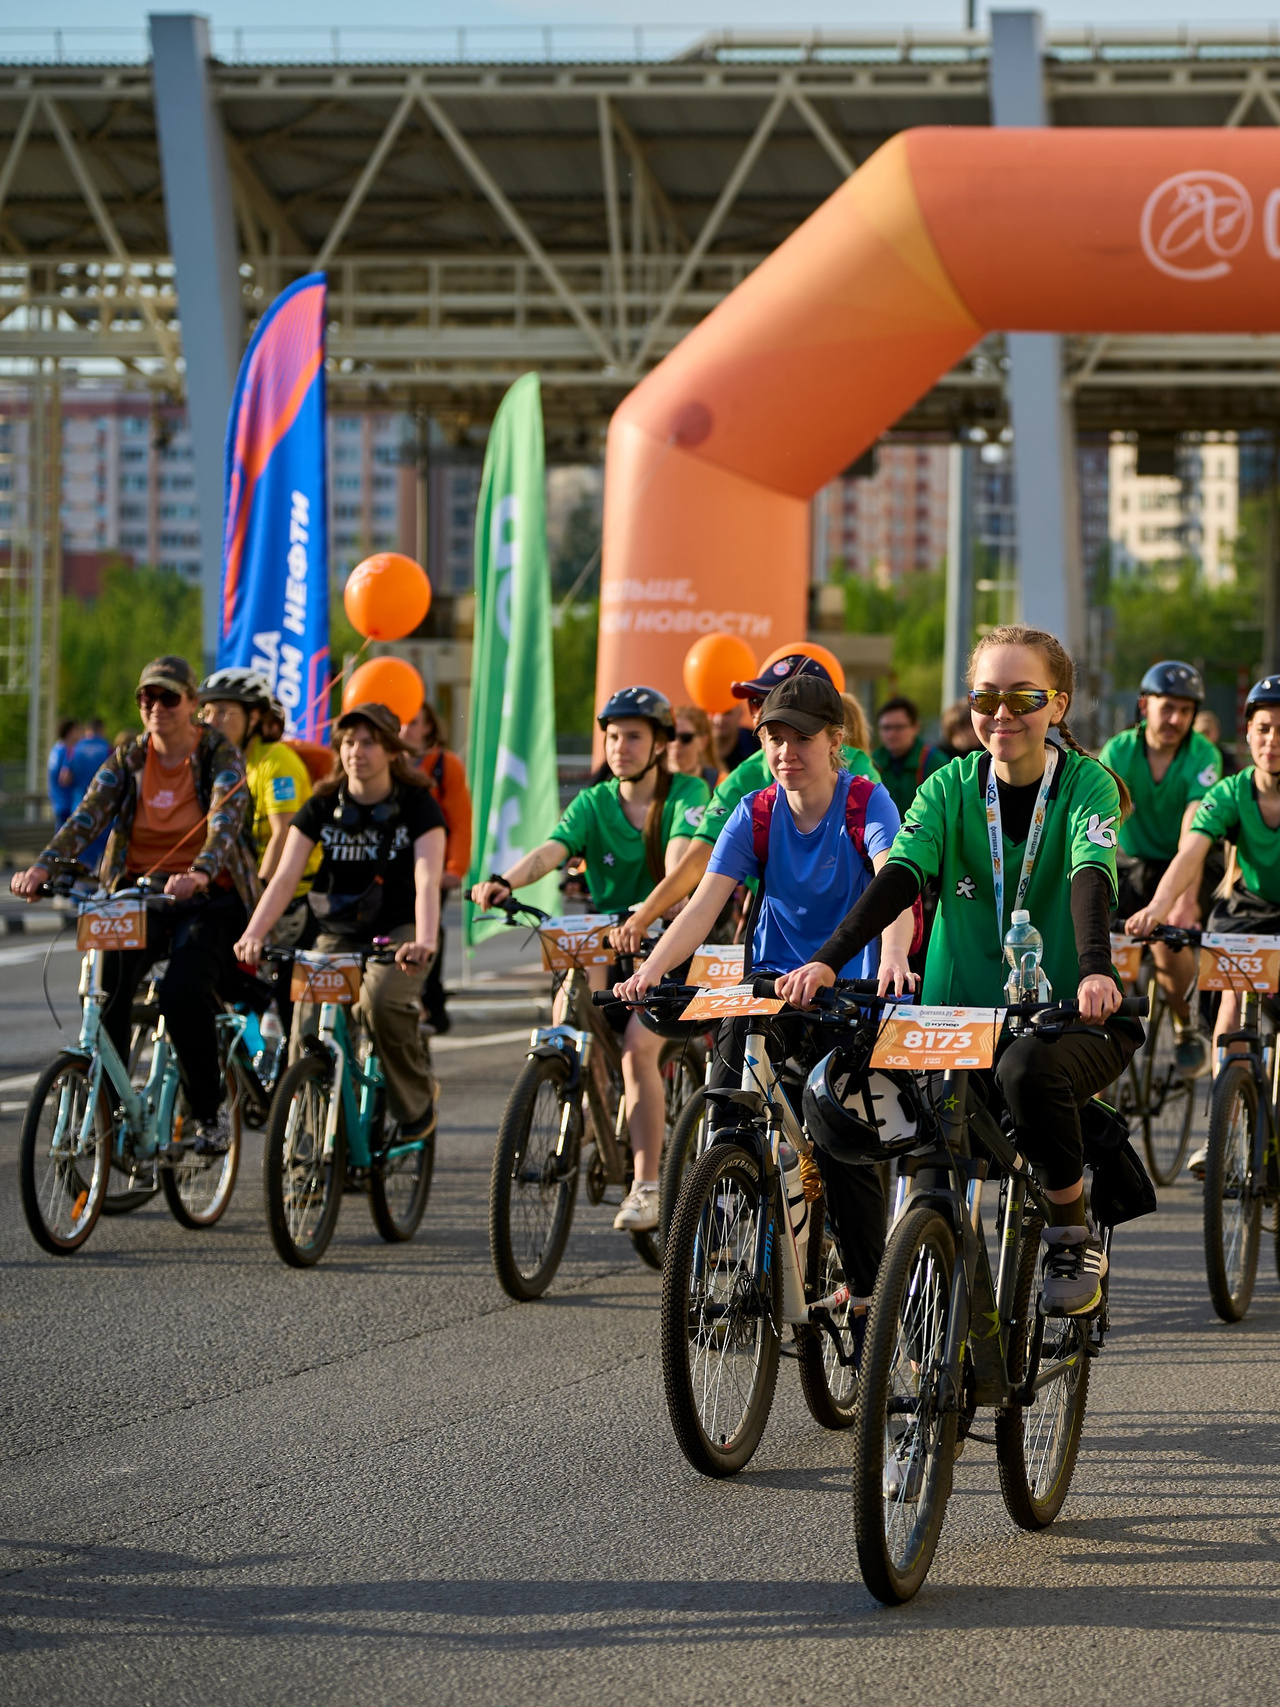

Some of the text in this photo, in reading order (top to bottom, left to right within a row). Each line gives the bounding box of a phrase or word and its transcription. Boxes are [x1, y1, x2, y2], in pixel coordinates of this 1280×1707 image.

[282, 489, 310, 636] НЕФТИ
[634, 609, 772, 639] НОВОСТИ
[90, 919, 133, 935] 6743
[707, 963, 744, 976] 816
[1217, 957, 1263, 973] 8163
[709, 995, 766, 1009] 7417
[903, 1030, 973, 1049] 8173
